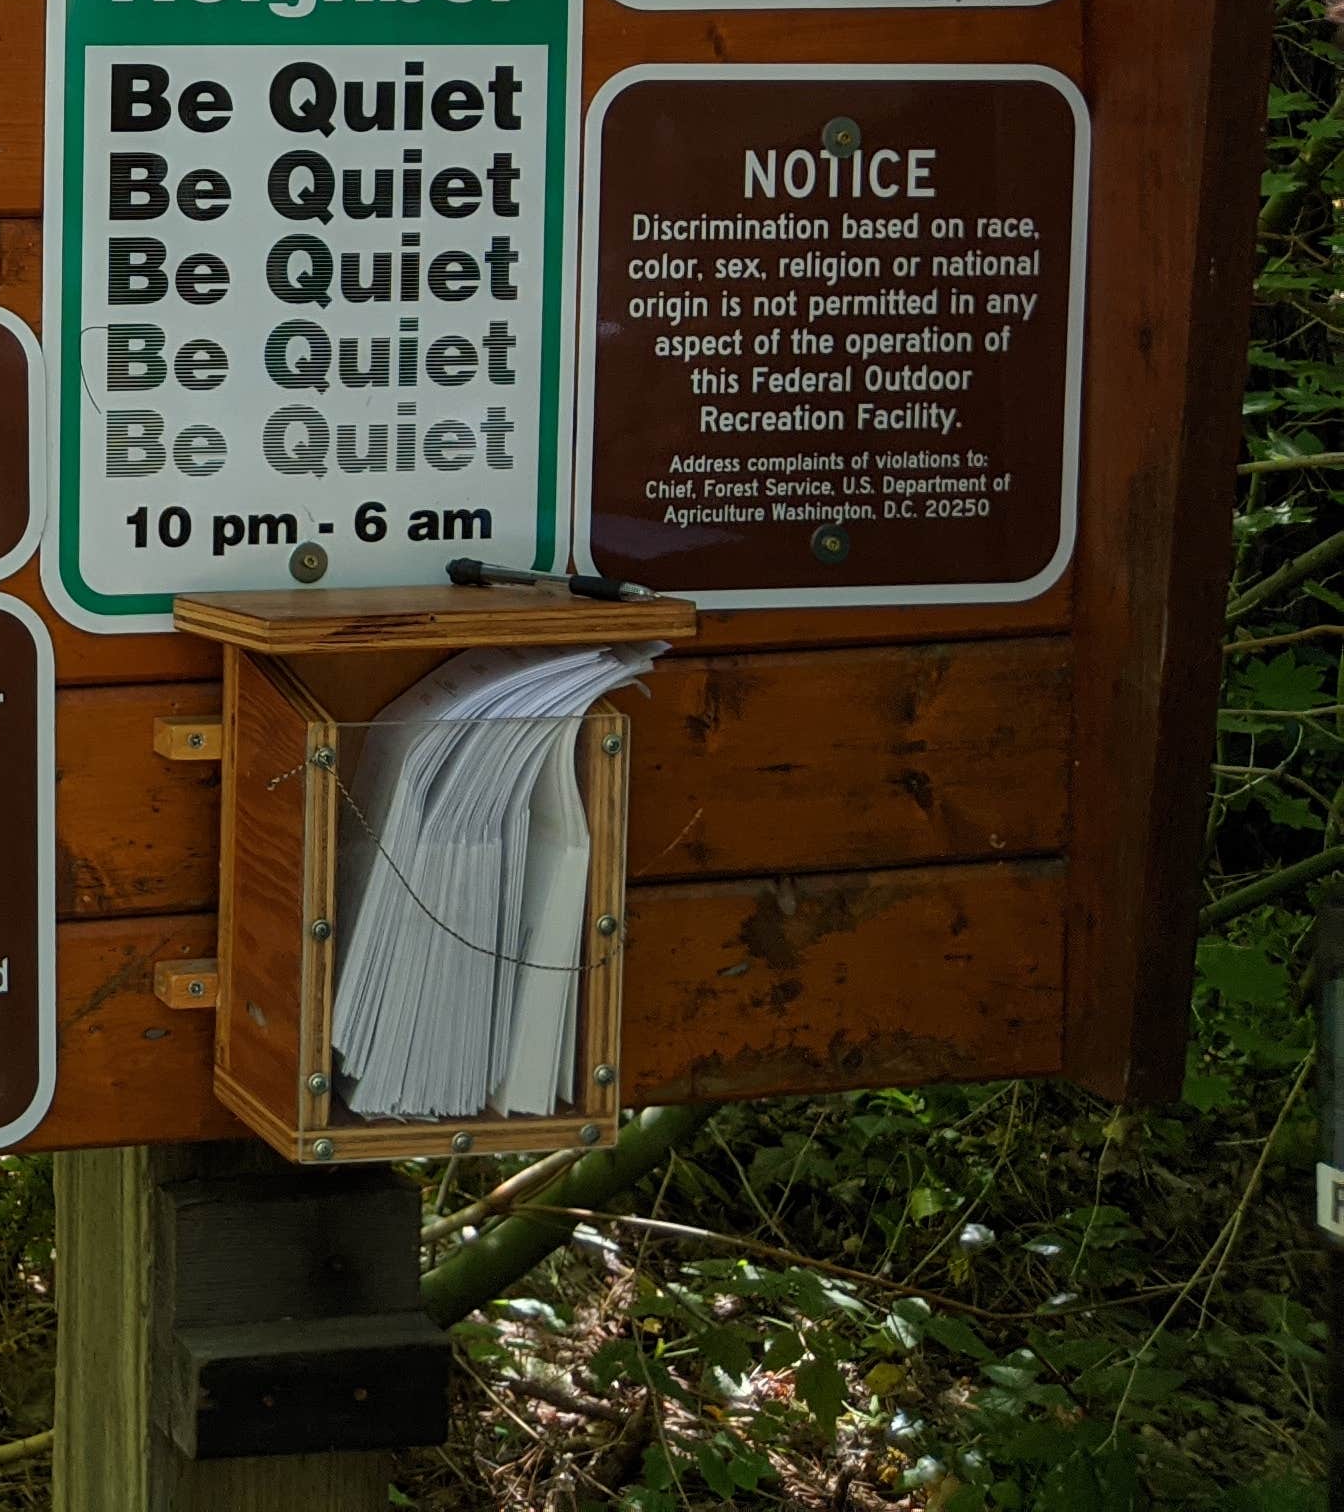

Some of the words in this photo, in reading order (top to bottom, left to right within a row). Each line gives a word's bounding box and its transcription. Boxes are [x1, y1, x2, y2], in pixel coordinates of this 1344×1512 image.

[111, 64, 233, 133] Be
[270, 62, 522, 138] Quiet
[109, 152, 231, 221] Be
[268, 149, 520, 225] Quiet
[745, 150, 935, 198] NOTICE
[633, 213, 828, 240] Discrimination
[843, 213, 918, 238] based
[932, 219, 963, 238] on
[108, 237, 230, 305] Be
[266, 232, 518, 309] Quiet
[629, 253, 702, 280] color,
[715, 259, 766, 279] sex,
[780, 251, 880, 285] religion
[893, 257, 920, 276] or
[933, 250, 1039, 276] national
[630, 291, 707, 326] origin
[722, 291, 740, 316] is
[754, 290, 797, 316] not
[809, 289, 937, 322] permitted
[951, 288, 974, 314] in
[987, 294, 1037, 320] any
[107, 323, 228, 391] Be
[265, 318, 516, 392] Quiet
[655, 329, 742, 362] aspect
[754, 328, 780, 354] of
[791, 328, 833, 354] the
[846, 327, 971, 360] operation
[985, 326, 1010, 351] of
[691, 368, 738, 393] this
[753, 366, 851, 392] Federal
[865, 365, 972, 391] Outdoor
[701, 405, 843, 432] Recreation
[858, 403, 961, 434] Facility.
[106, 410, 227, 477] Be
[263, 402, 514, 477] Quiet
[670, 455, 740, 473] Address
[748, 453, 843, 474] complaints
[852, 452, 868, 469] of
[876, 451, 960, 468] violations
[967, 450, 987, 466] to:
[705, 479, 758, 497] Forest
[843, 477, 874, 494] U.S.
[883, 474, 986, 496] Department
[993, 474, 1010, 491] of
[127, 506, 191, 548] 10
[213, 514, 297, 556] pm
[355, 502, 387, 542] 6
[408, 502, 491, 541] am
[664, 505, 764, 528] Agriculture
[884, 500, 916, 518] D.C.
[926, 499, 989, 517] 20250
